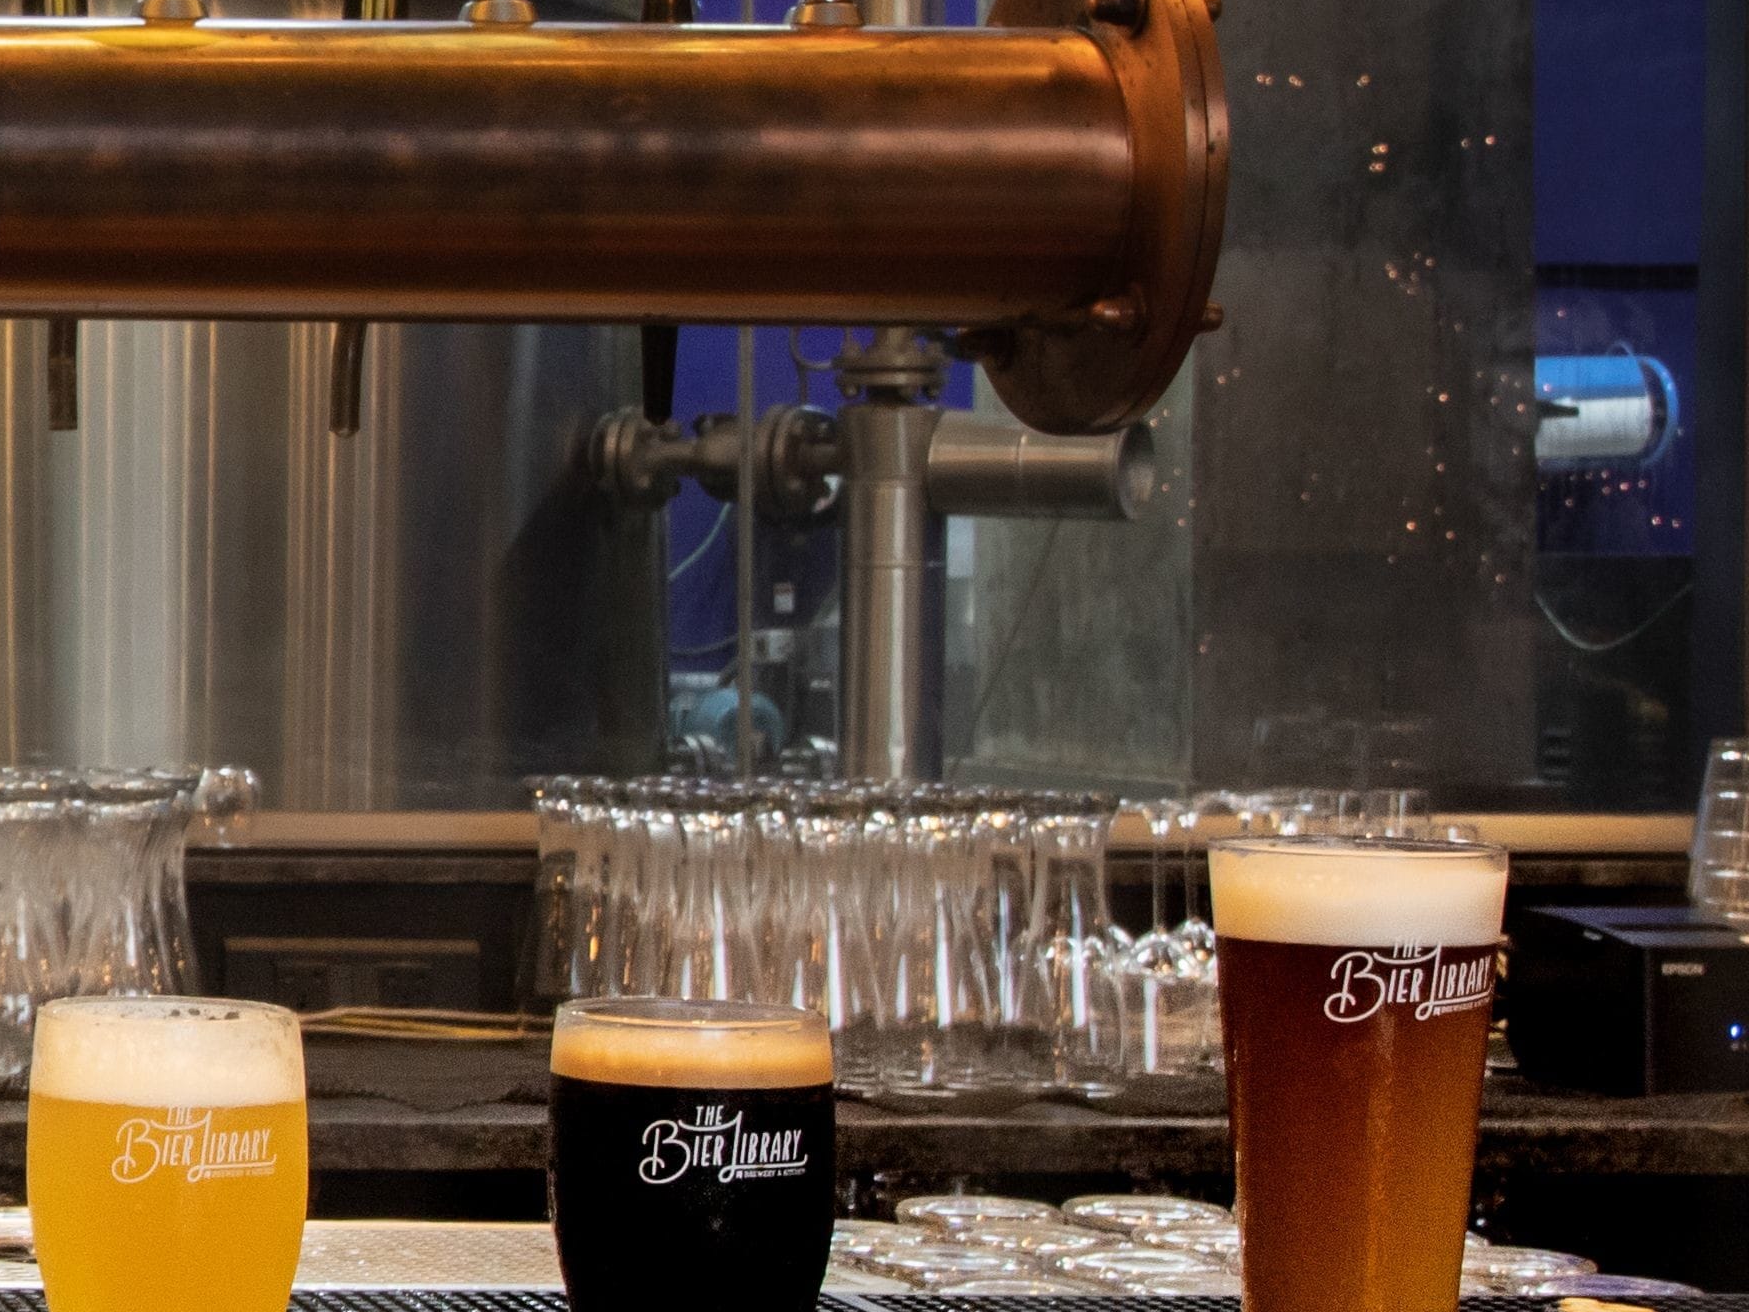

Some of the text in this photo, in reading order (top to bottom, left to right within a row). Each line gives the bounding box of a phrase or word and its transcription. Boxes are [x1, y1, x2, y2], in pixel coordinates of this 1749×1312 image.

[1391, 938, 1423, 959] THE
[1323, 940, 1494, 1023] BIER LIBRARY
[165, 1105, 195, 1125] THE
[695, 1104, 725, 1127] THE
[111, 1109, 277, 1184] BIER LIBRARY
[638, 1109, 809, 1185] BIER LIBRARY
